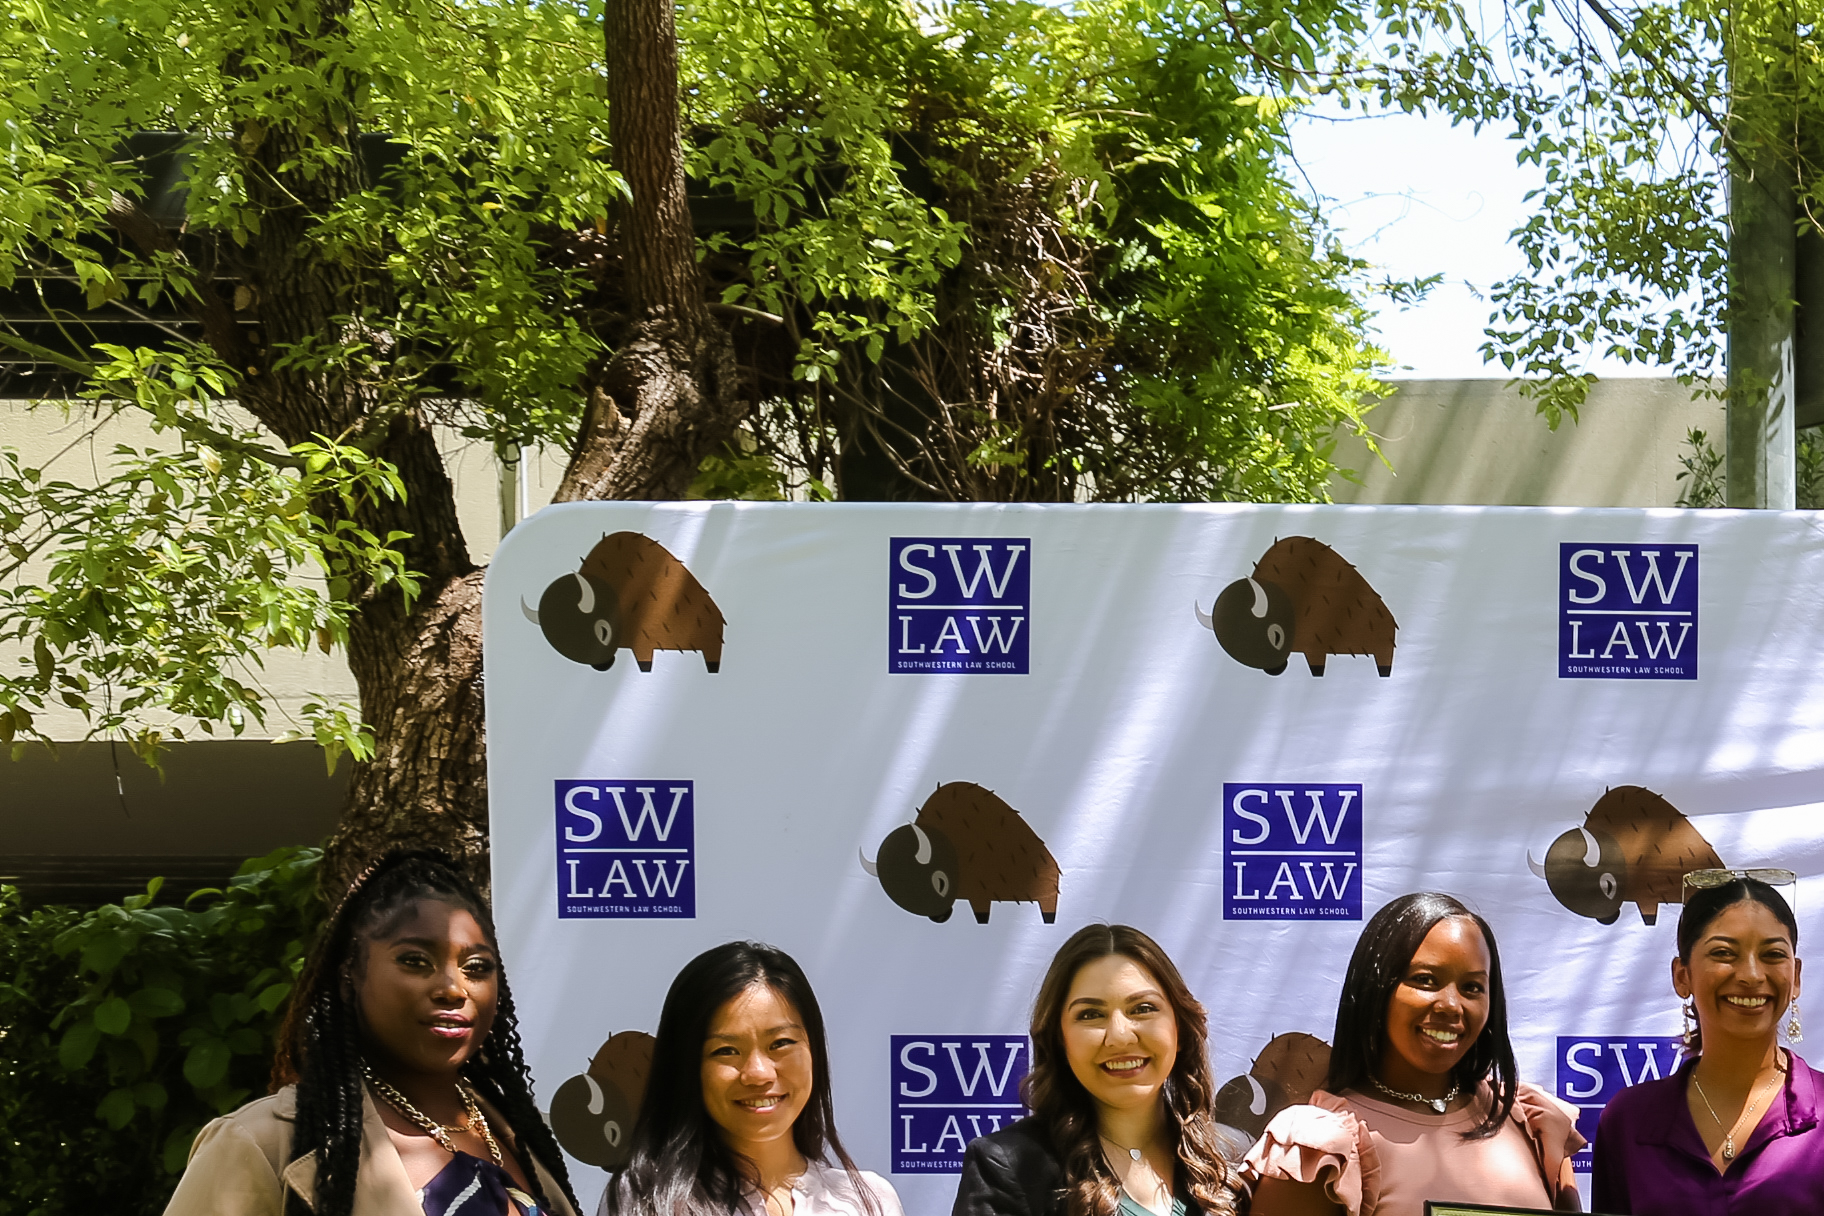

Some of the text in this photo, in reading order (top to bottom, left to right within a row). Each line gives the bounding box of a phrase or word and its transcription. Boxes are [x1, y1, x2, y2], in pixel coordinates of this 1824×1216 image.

[899, 544, 1025, 598] SW
[1569, 549, 1693, 604] SW
[899, 616, 1024, 653] LAW
[1569, 621, 1692, 659] LAW
[1635, 666, 1650, 674] LAW
[565, 786, 688, 842] SW
[1233, 789, 1357, 844] SW
[566, 860, 689, 897] LAW
[1233, 862, 1357, 900] LAW
[901, 1042, 1024, 1097] SW
[1566, 1042, 1686, 1097] SW
